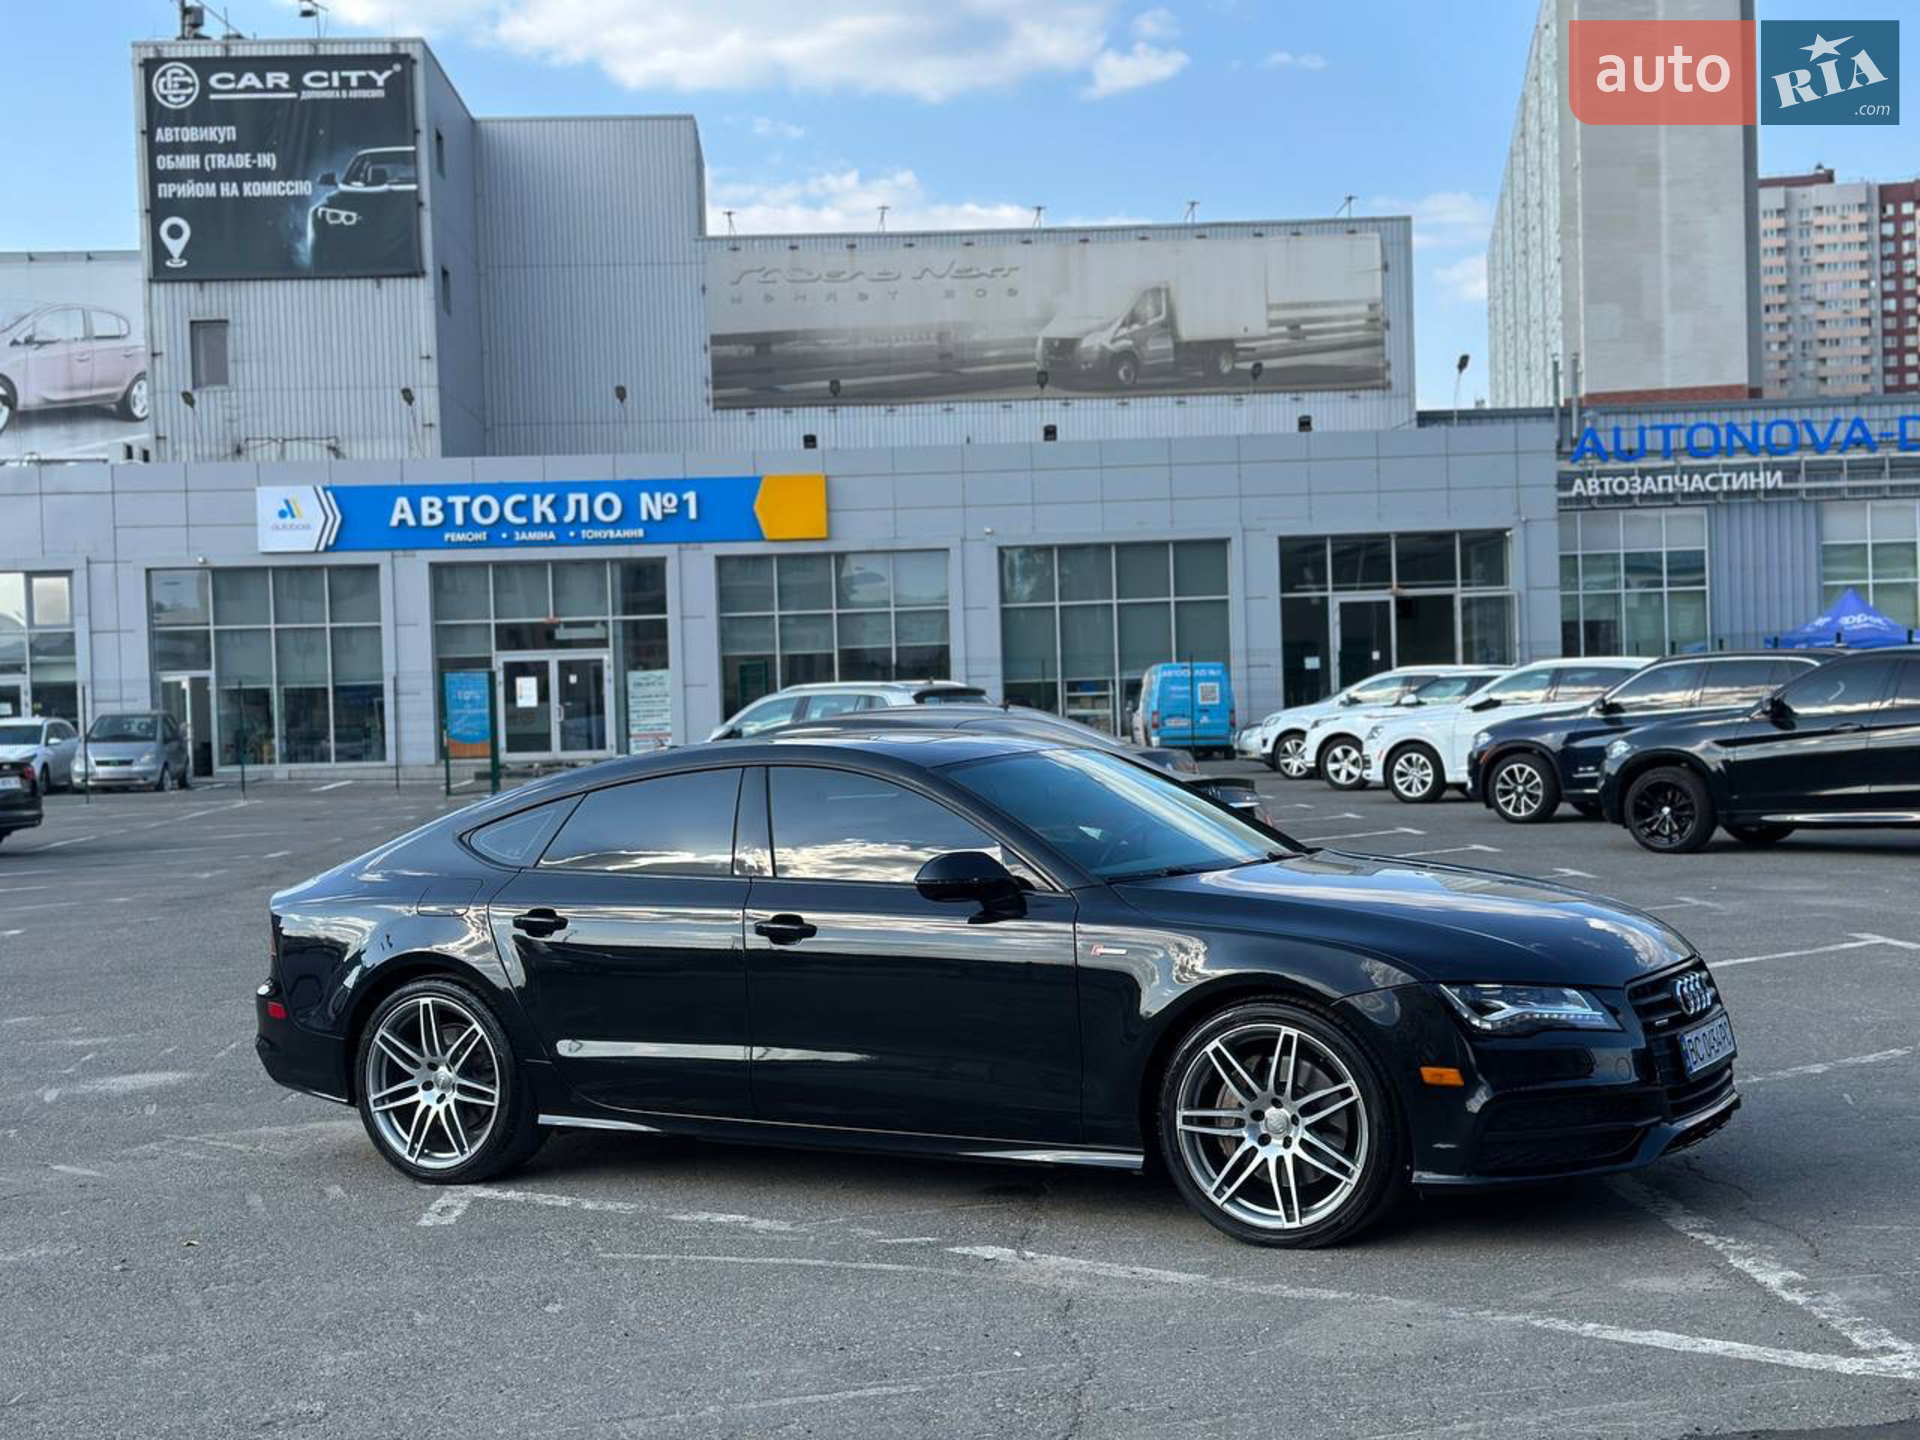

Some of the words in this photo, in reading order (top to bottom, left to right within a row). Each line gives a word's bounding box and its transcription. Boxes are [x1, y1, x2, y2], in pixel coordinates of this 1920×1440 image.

[209, 71, 290, 90] CAR
[302, 69, 394, 88] CITY
[155, 126, 237, 144] АВТОВИКУП
[156, 154, 200, 170] ОБМІН
[204, 152, 277, 172] (TRADE-IN)
[157, 179, 216, 199] ПРИЙОМ
[220, 182, 239, 197] НА
[1571, 470, 1784, 497] АВТОЗАПЧАСТИНИ
[389, 492, 623, 528] АВТОСКЛО
[640, 490, 698, 522] №1
[444, 531, 488, 542] РЕМОНТ
[514, 530, 556, 541] ЗАМІНА
[581, 528, 644, 540] ТОНУВАННЯ
